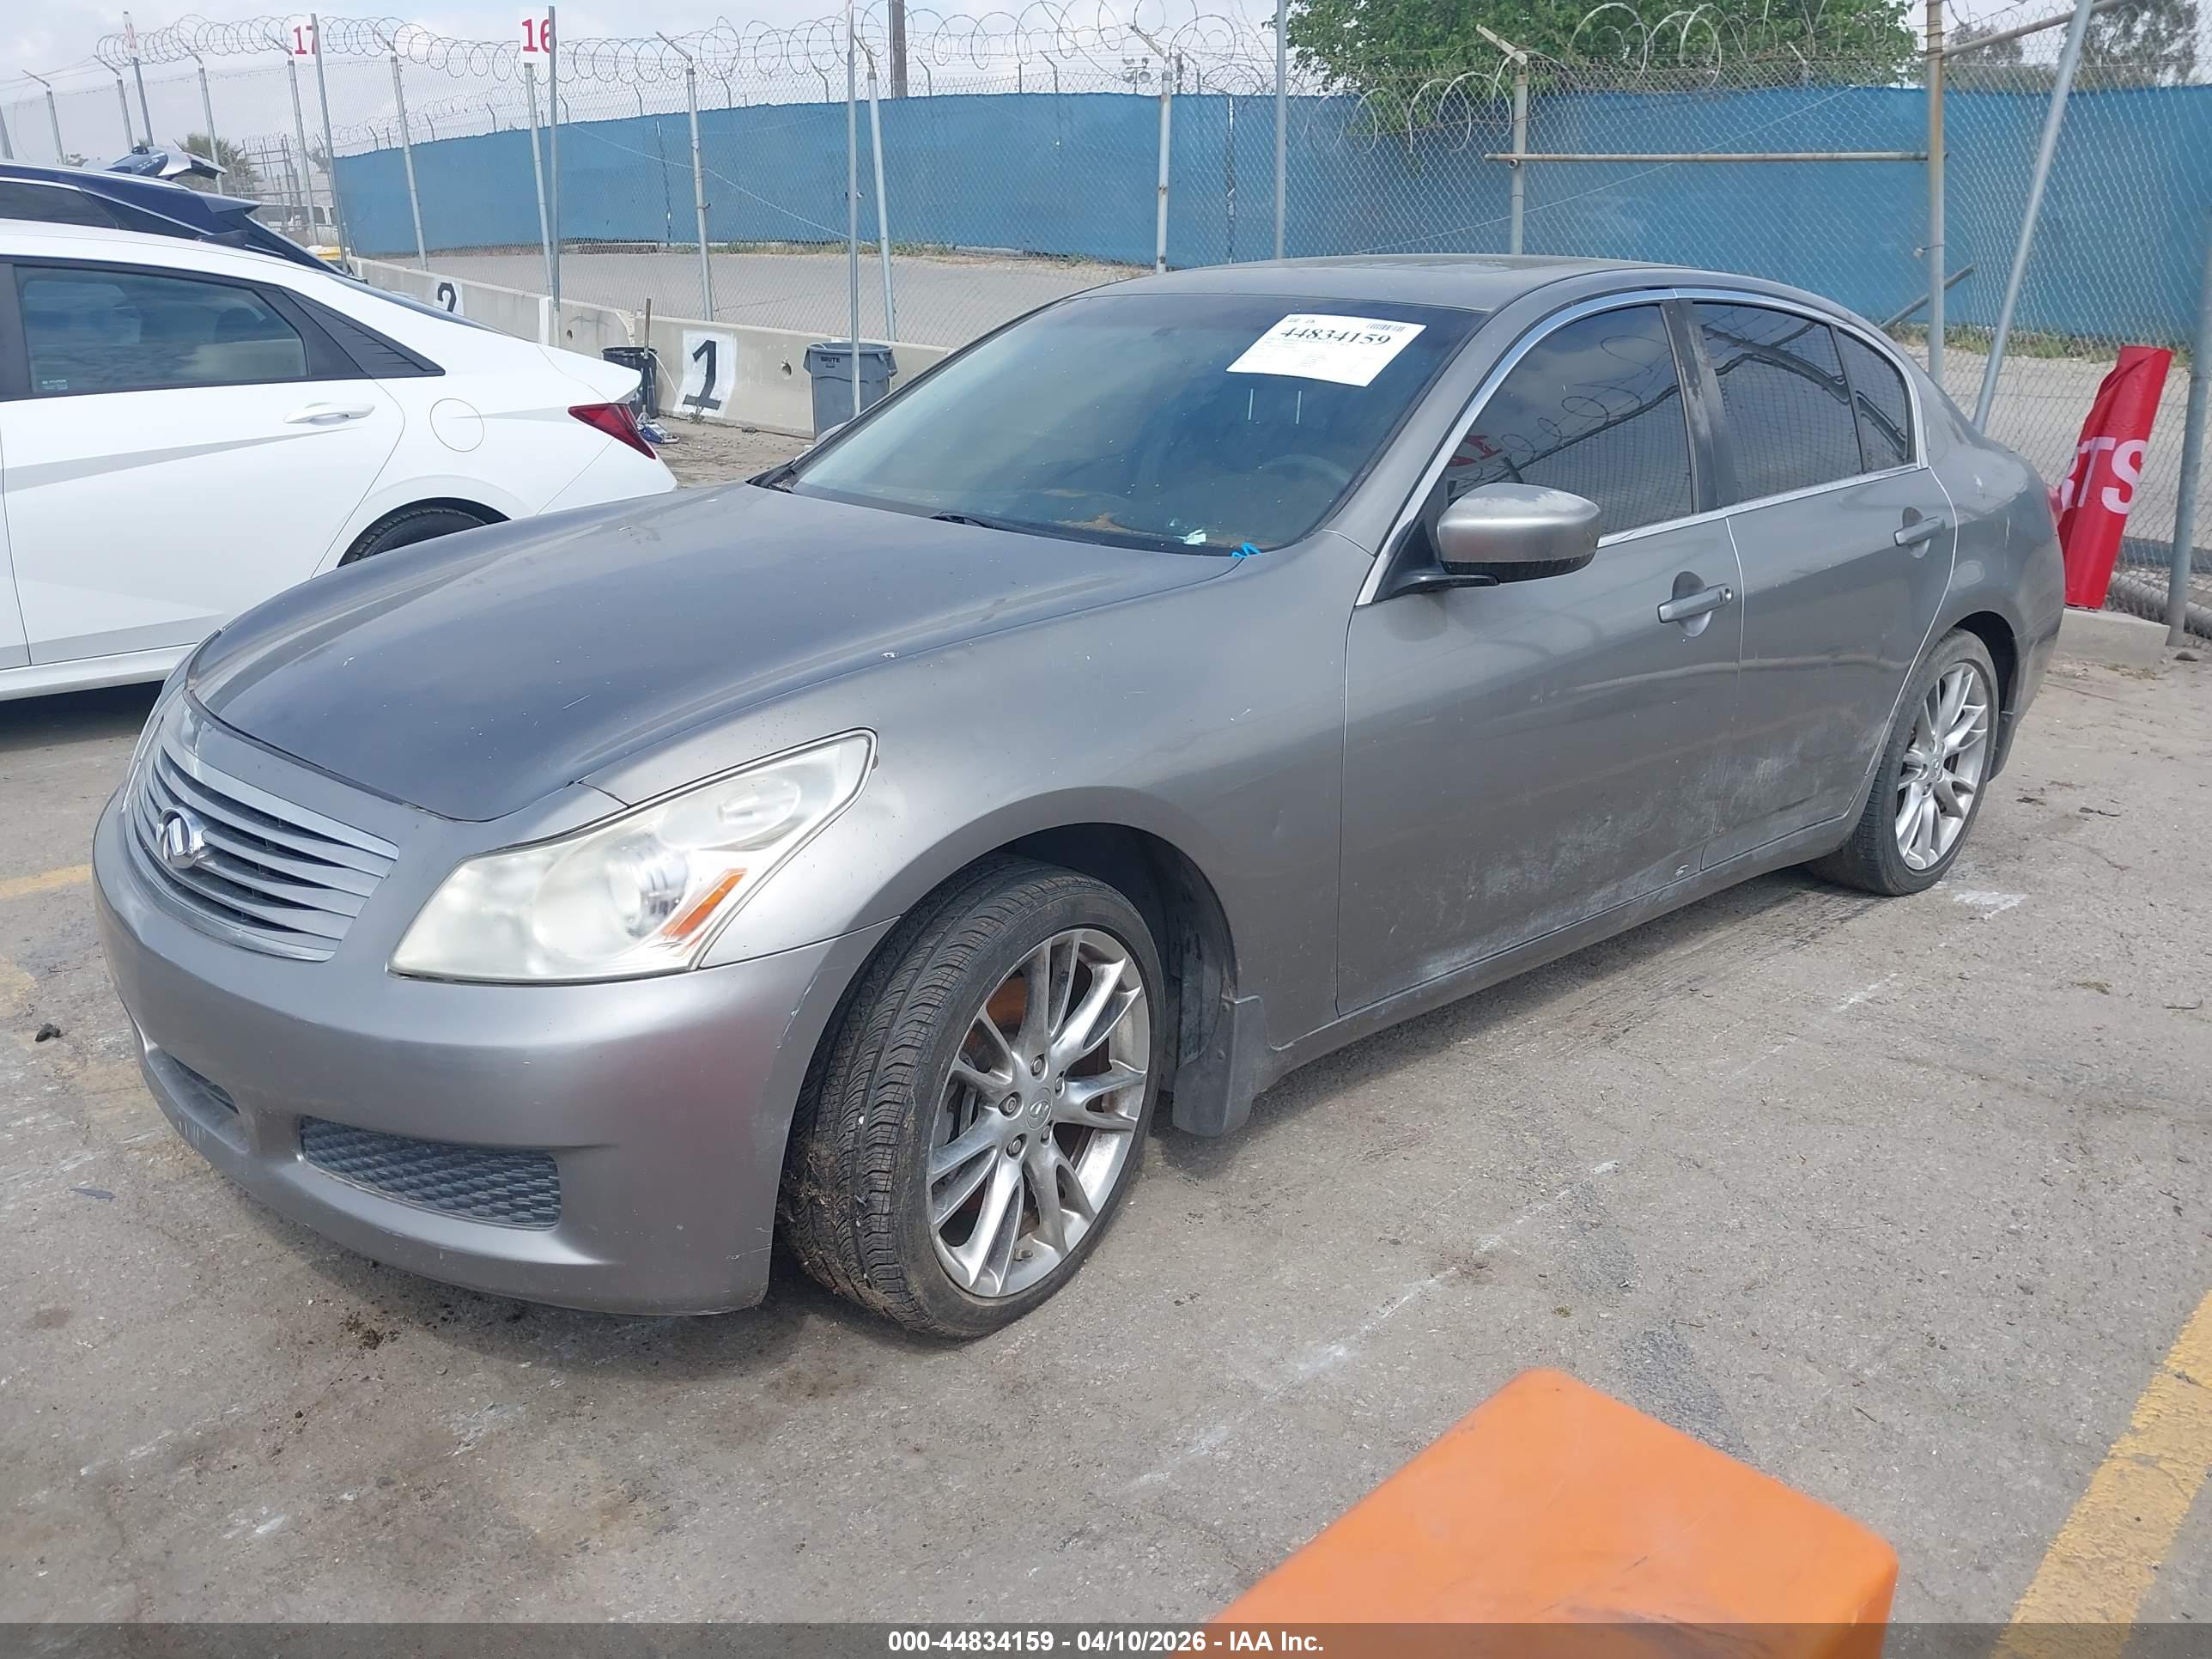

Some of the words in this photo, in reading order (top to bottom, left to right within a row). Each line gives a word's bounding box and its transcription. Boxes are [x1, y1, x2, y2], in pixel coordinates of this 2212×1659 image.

[522, 18, 550, 53] 16
[1280, 327, 1391, 345] 44834159
[683, 339, 721, 410] 1
